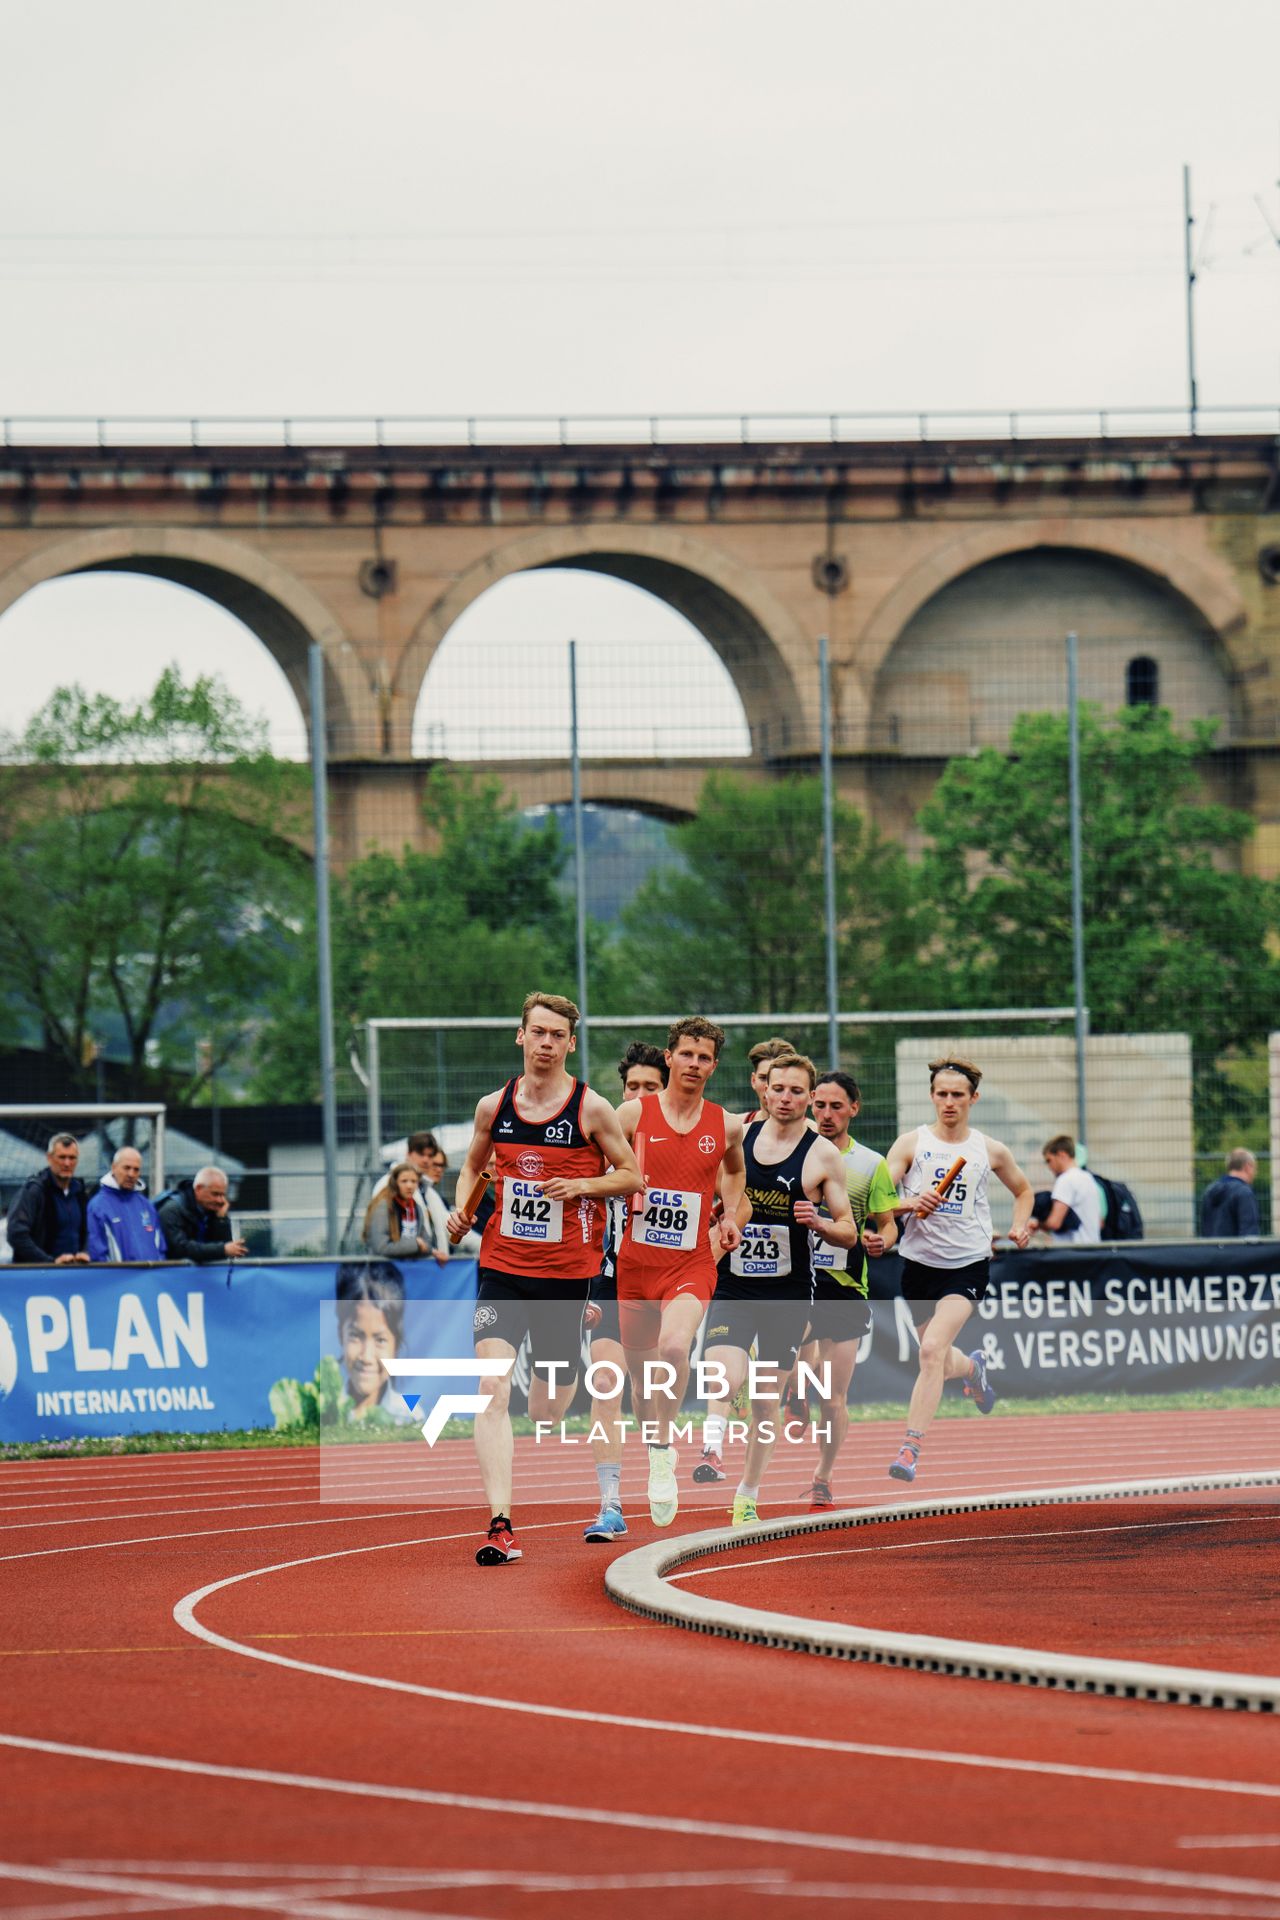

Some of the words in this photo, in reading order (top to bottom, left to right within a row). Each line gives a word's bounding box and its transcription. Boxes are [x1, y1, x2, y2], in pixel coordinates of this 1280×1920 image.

[545, 1126, 564, 1139] OS
[511, 1198, 551, 1222] 442
[644, 1206, 688, 1231] 498
[525, 1225, 546, 1234] PLAN
[660, 1233, 681, 1242] PLAN
[740, 1240, 780, 1259] 243
[978, 1280, 1093, 1320] GEGEN
[25, 1292, 209, 1373] PLAN
[983, 1333, 1006, 1370] &
[36, 1386, 215, 1417] INTERNATIONAL
